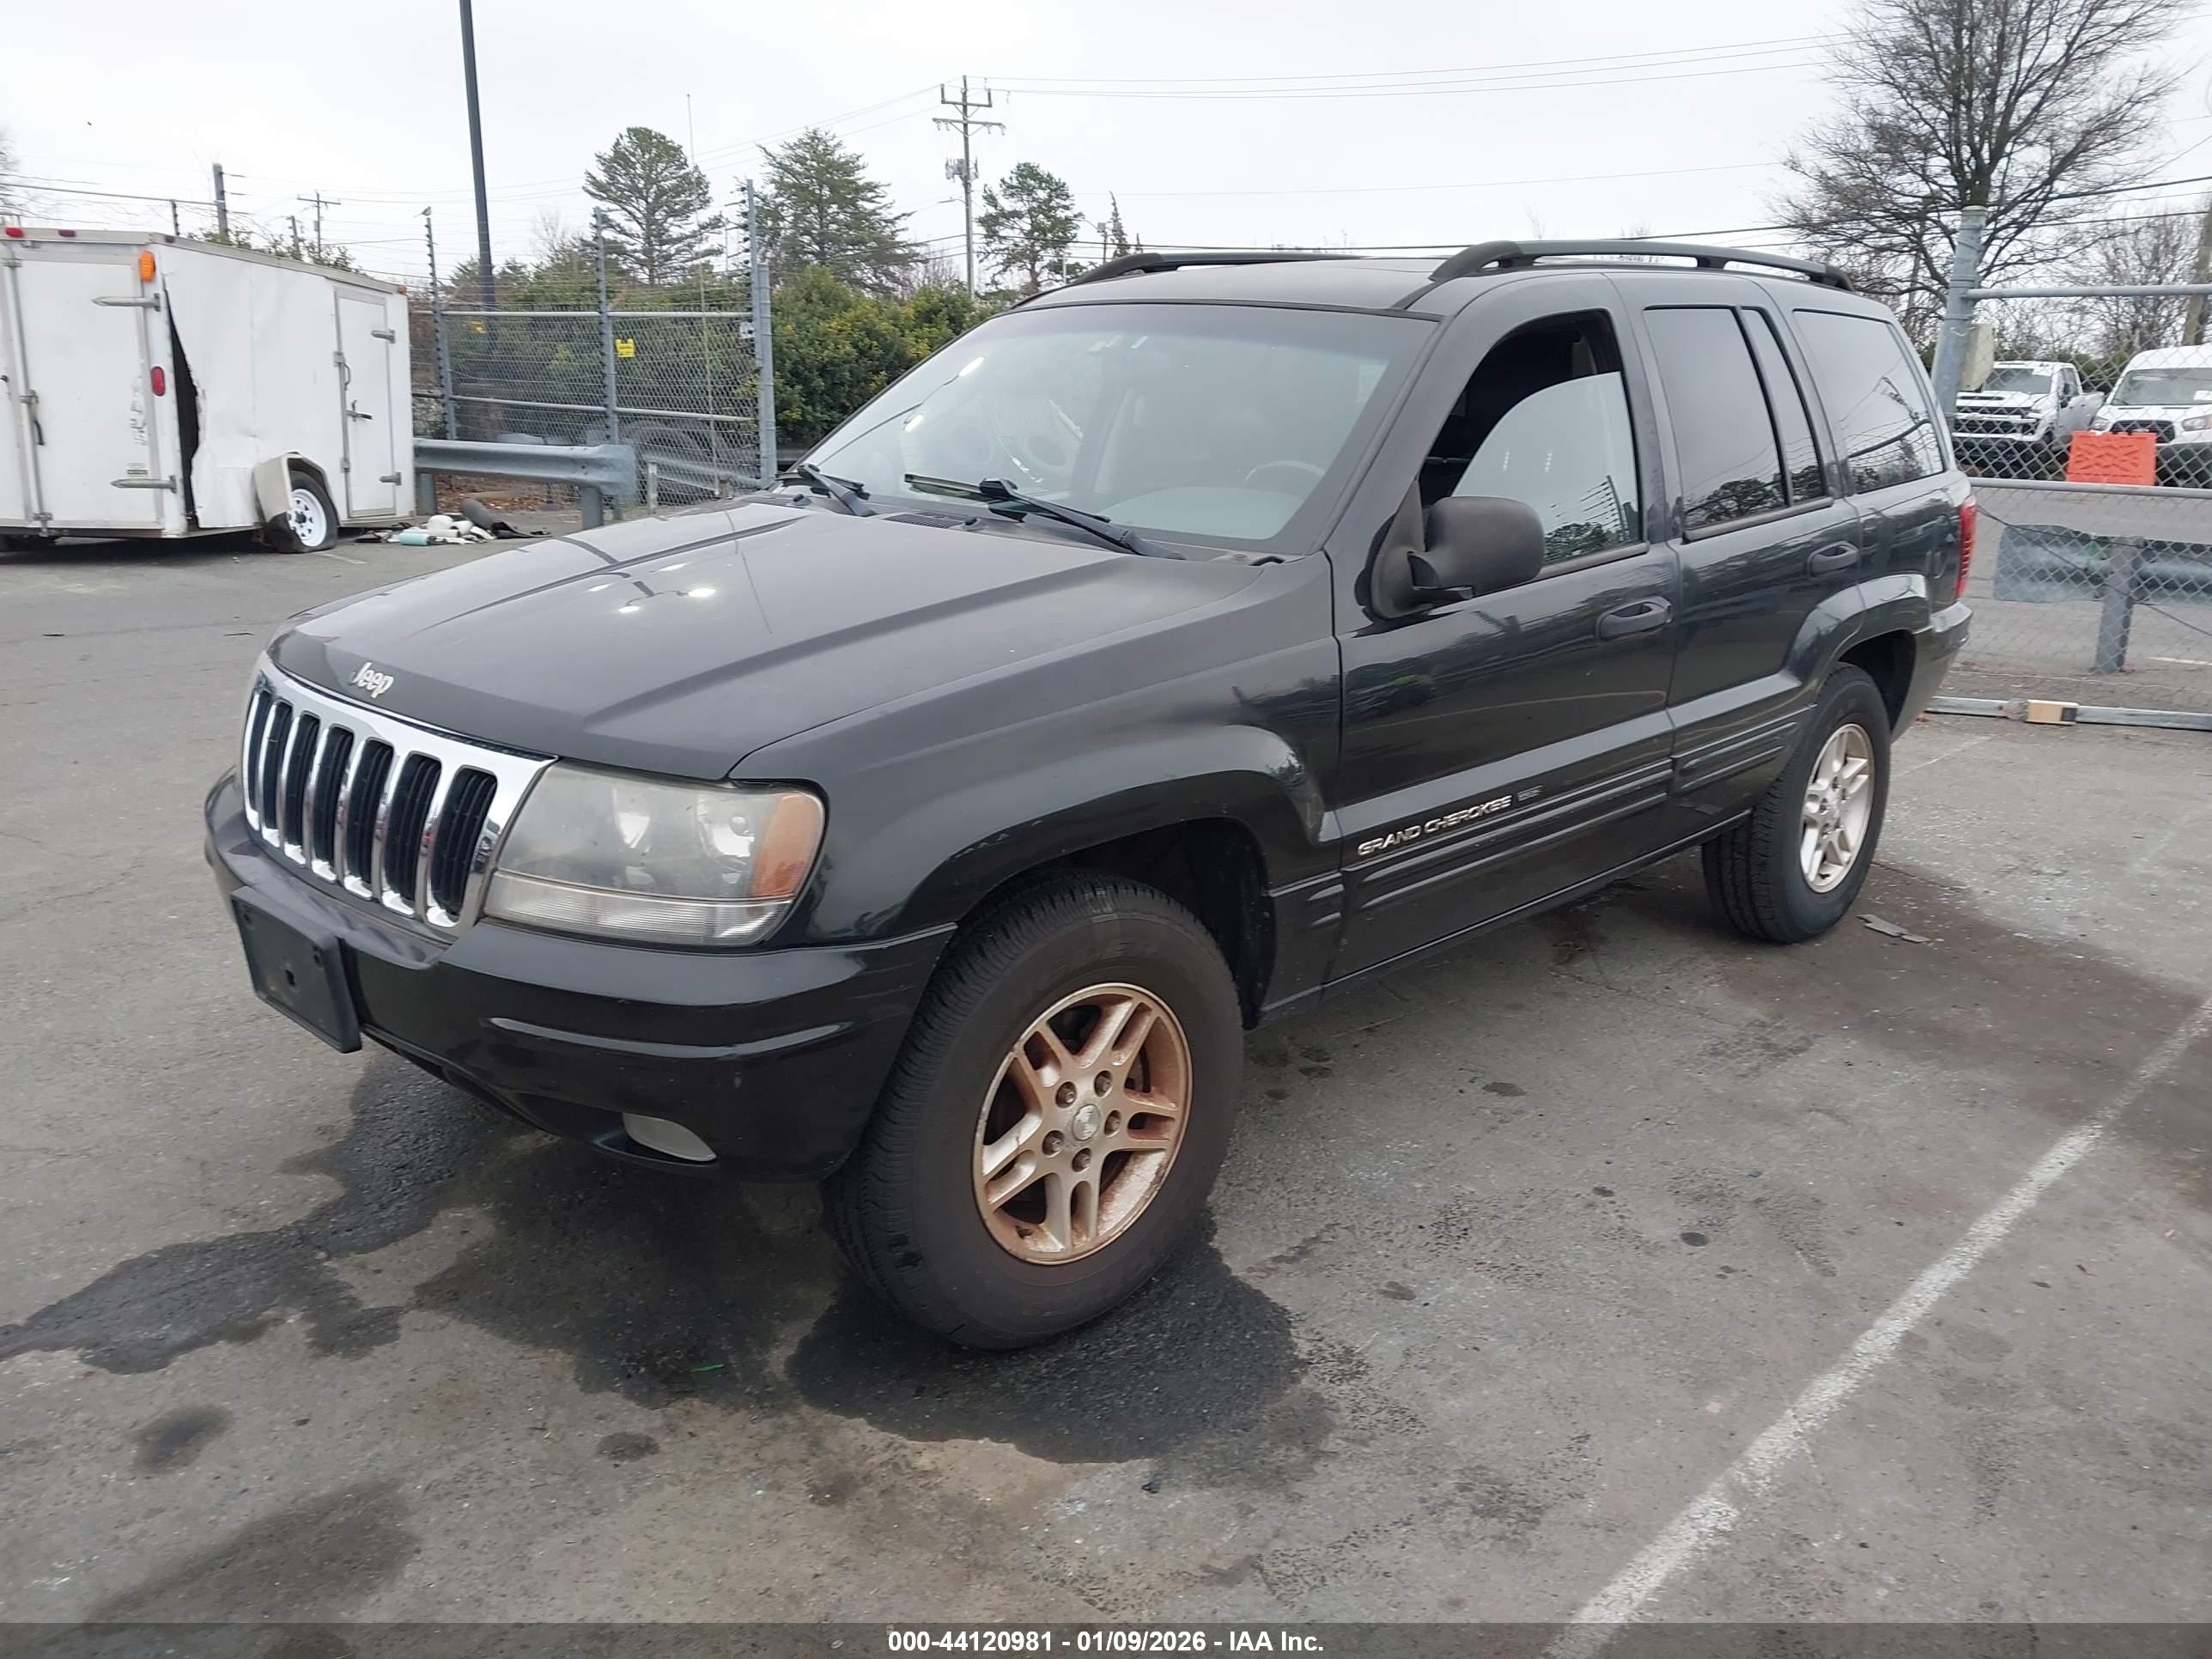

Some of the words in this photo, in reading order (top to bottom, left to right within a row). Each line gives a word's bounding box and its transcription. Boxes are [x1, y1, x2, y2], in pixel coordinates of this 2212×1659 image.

[349, 661, 394, 699] Jeep
[1357, 825, 1422, 857] GRAND
[1424, 794, 1513, 834] CHEROKEE
